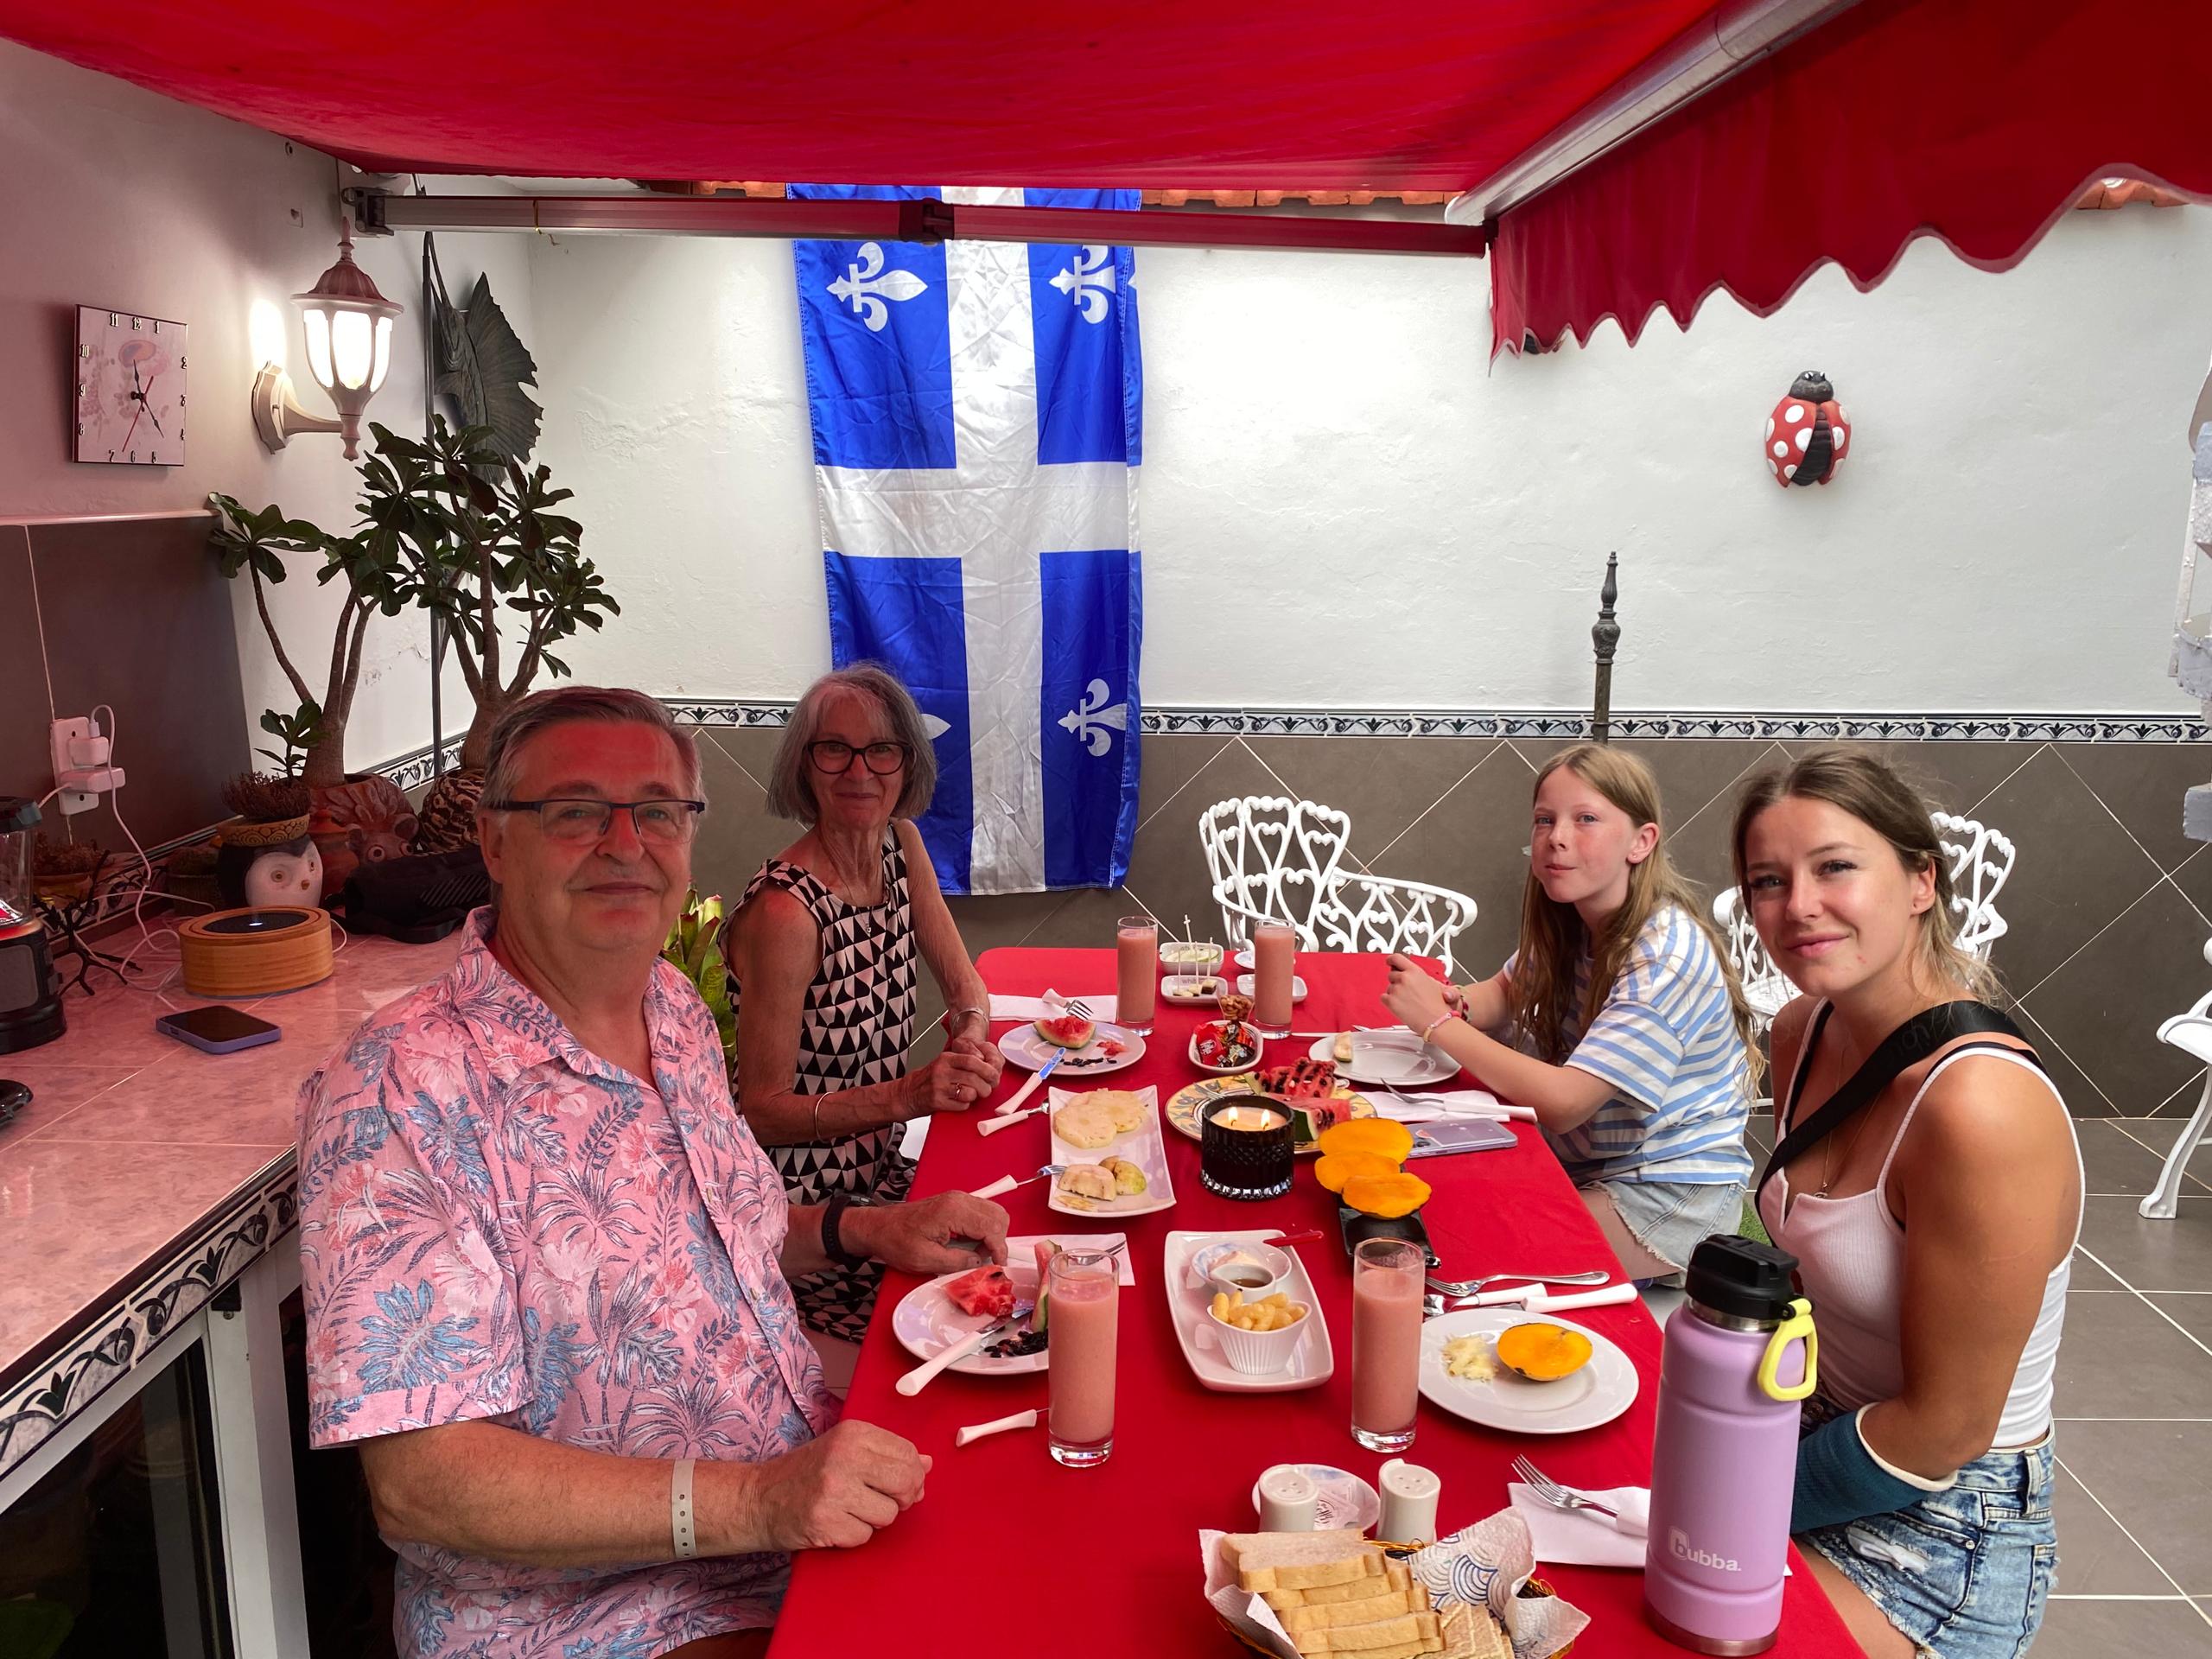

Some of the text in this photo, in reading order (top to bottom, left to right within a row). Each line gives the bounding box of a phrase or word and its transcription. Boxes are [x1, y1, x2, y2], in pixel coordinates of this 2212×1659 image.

[110, 313, 118, 327] 11
[132, 316, 143, 331] 12
[154, 321, 160, 334] 1
[79, 344, 90, 358] 10
[181, 356, 188, 370] 2
[79, 383, 86, 397] 9
[108, 449, 115, 463] 7
